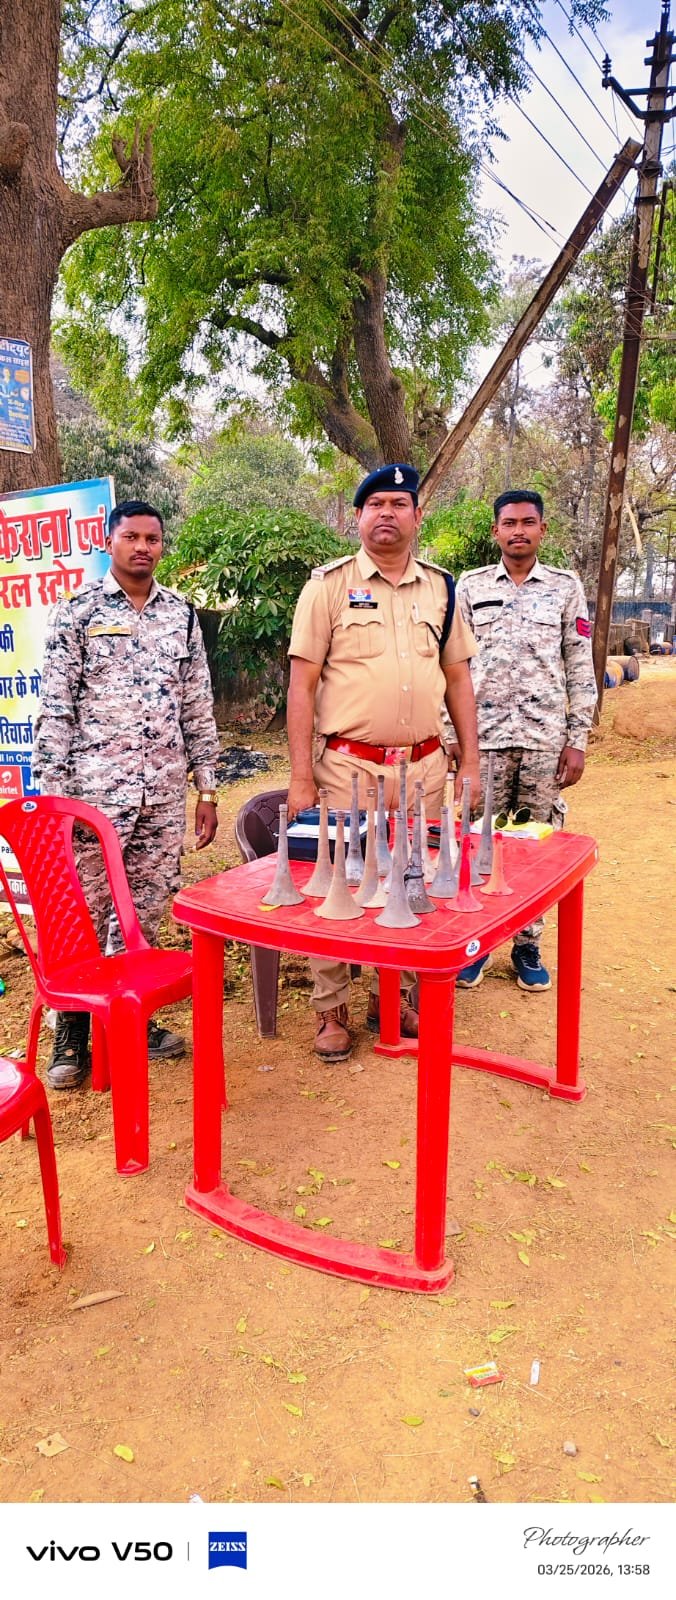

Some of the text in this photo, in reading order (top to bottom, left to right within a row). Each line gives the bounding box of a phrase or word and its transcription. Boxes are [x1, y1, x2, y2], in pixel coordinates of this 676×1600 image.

[75, 506, 105, 551] एवं
[15, 669, 27, 698] के
[6, 753, 14, 762] In
